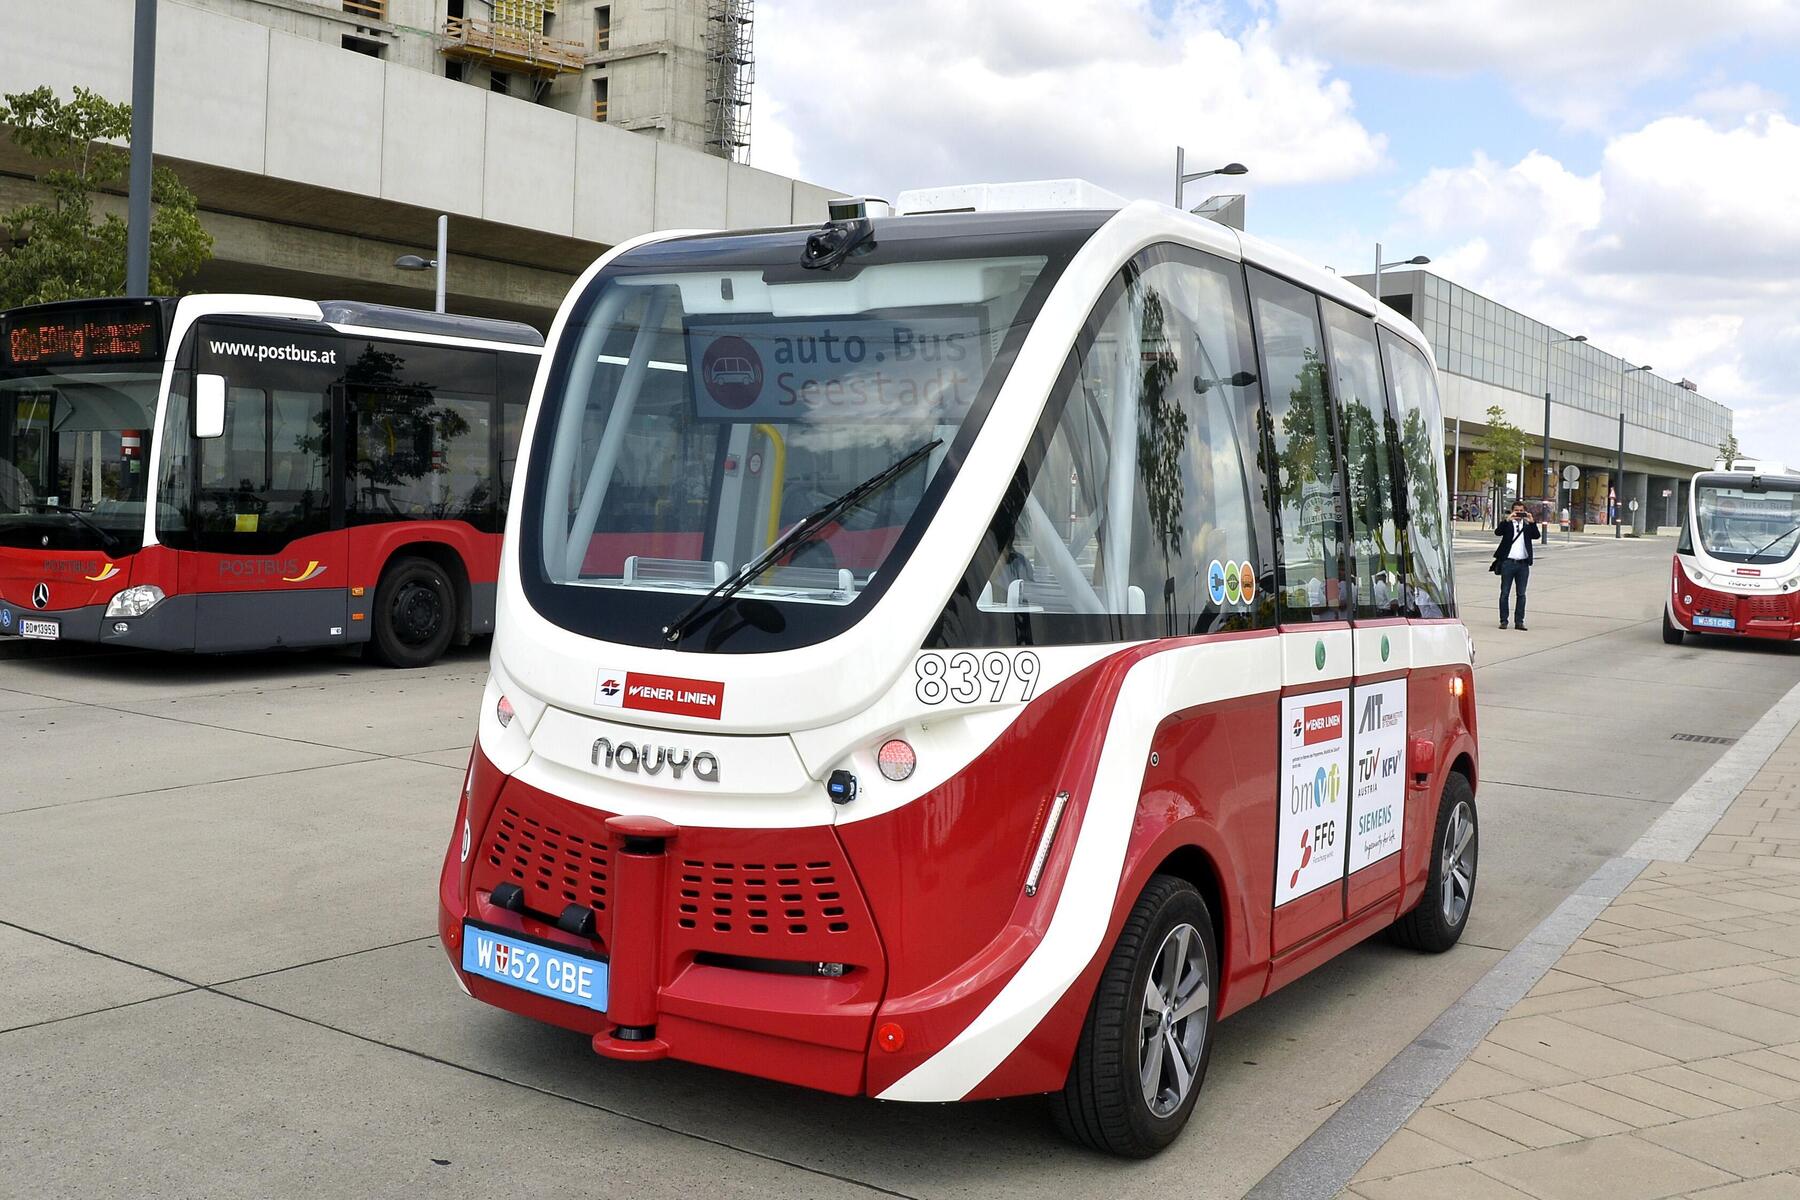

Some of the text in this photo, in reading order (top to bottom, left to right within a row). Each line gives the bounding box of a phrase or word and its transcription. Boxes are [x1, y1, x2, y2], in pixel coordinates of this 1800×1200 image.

[209, 340, 337, 364] www.postbus.at
[774, 327, 967, 363] auto.Bus
[777, 368, 970, 407] Seestadt
[44, 560, 97, 574] POSTBUS
[218, 559, 299, 576] POSTBUS
[915, 650, 1041, 705] 8399
[628, 685, 717, 706] WIENER LINIEN
[1305, 714, 1341, 731] WIENER LINIEN
[1358, 693, 1383, 735] AIT
[591, 736, 721, 783] navya
[1358, 747, 1380, 783] TÜV
[1357, 783, 1378, 797] AUSTRIA
[1313, 819, 1335, 853] FFG
[1358, 804, 1392, 836] SIEMENS
[477, 937, 594, 999] W 52 CBE
